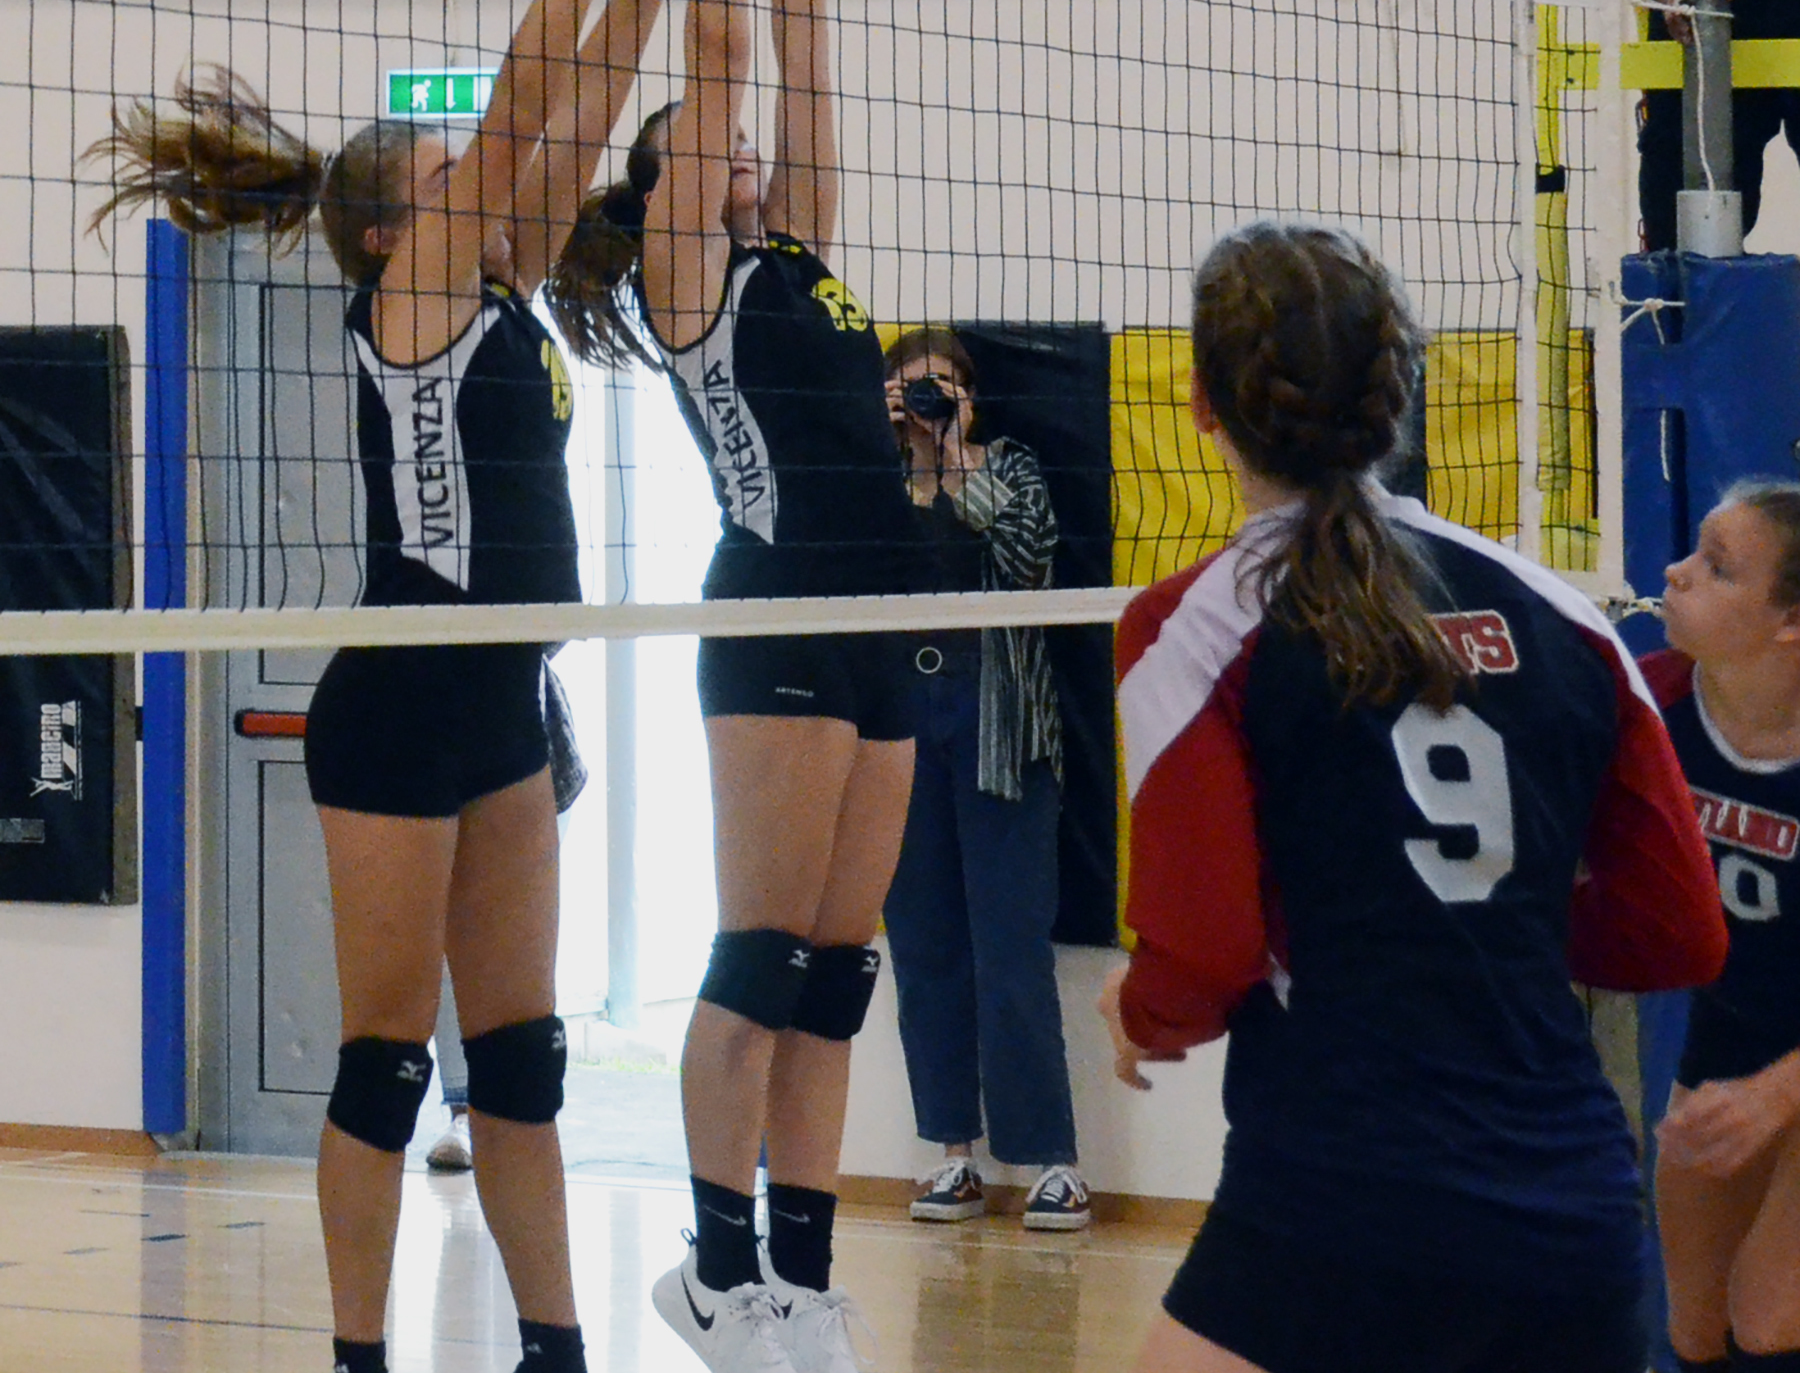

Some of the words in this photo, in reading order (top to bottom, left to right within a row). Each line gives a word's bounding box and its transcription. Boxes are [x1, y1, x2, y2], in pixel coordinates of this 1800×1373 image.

[411, 377, 454, 549] VICENZA
[704, 360, 765, 509] VICENZA
[1391, 703, 1515, 904] 9
